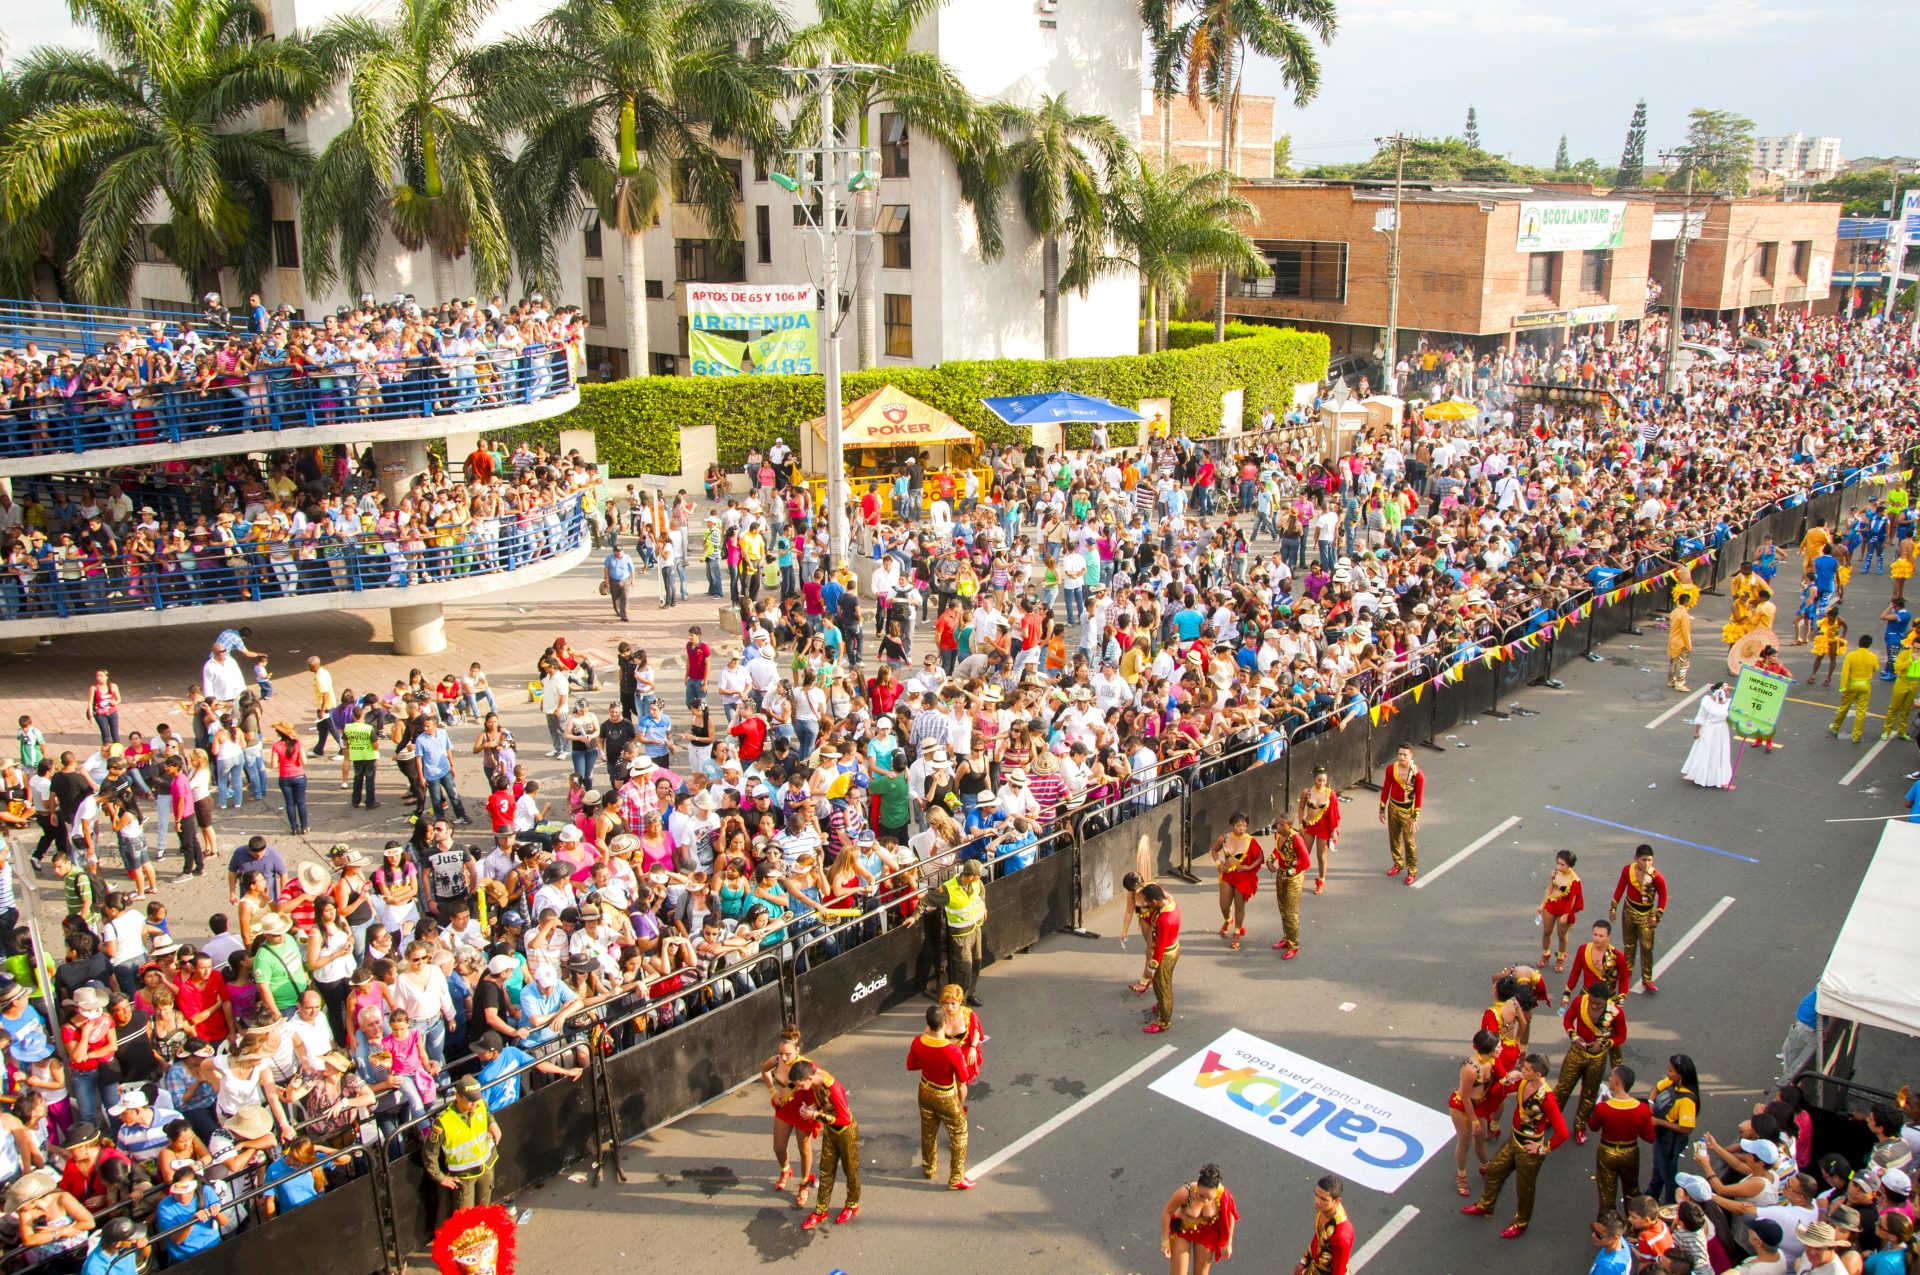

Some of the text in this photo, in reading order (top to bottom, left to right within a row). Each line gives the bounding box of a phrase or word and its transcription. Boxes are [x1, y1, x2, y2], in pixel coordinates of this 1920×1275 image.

[1542, 208, 1610, 225] SCOTLAND YARD
[692, 291, 729, 302] APTOS
[731, 292, 747, 303] DE
[748, 293, 763, 303] 65
[764, 293, 772, 302] Y
[776, 292, 795, 302] 106
[692, 314, 811, 331] ARRIENDA
[867, 423, 932, 436] POKER
[890, 440, 917, 448] POKER
[944, 437, 971, 445] POKER
[1749, 676, 1778, 691] IMPACTO
[1749, 685, 1774, 697] LATINO
[1751, 702, 1762, 711] 16
[500, 799, 509, 813] 3
[436, 852, 463, 866] Just
[851, 977, 887, 1002] adidas
[1235, 1050, 1392, 1119] una ciudad para todos
